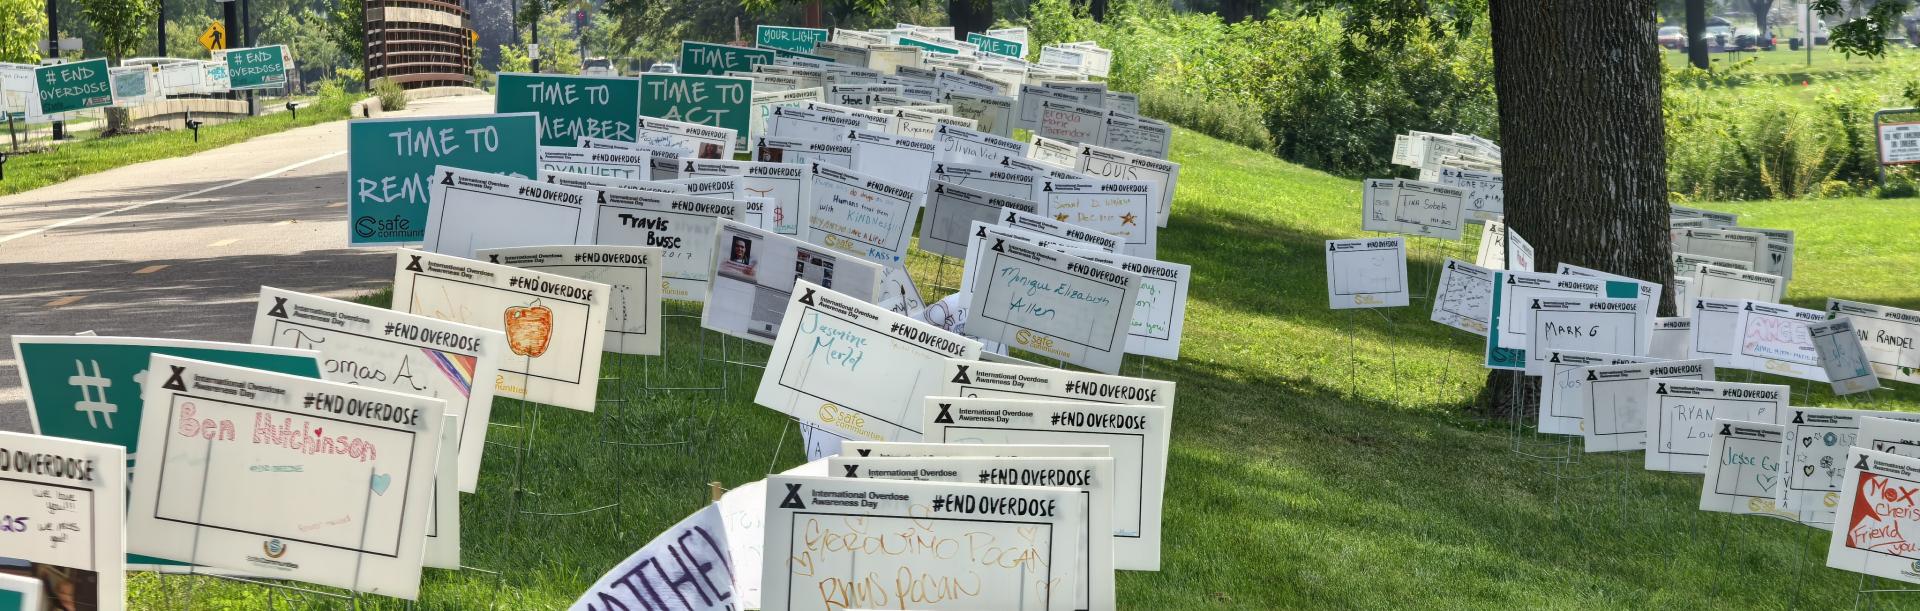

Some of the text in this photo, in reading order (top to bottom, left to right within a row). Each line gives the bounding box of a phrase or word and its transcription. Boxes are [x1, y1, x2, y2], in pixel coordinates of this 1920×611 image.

[764, 30, 821, 43] YOUR LIGHT
[971, 36, 1000, 52] TIME
[1005, 43, 1019, 54] TO
[246, 52, 272, 63] END
[688, 46, 768, 70] TIME TO
[61, 66, 95, 82] END
[229, 64, 282, 77] OVERDOSE
[40, 81, 109, 100] OVERDOSE
[527, 81, 610, 106] TIME TO
[648, 78, 744, 104] TIME TO
[661, 105, 730, 127] ACT
[388, 125, 499, 157] TIME TO
[592, 154, 641, 164] #END OVERDOSE
[652, 150, 680, 160] OVERDOSE
[749, 166, 802, 177] #END OVERDOSE
[990, 171, 1034, 183] #END OVERDOSE
[699, 180, 735, 191] OVERDOSE
[866, 180, 914, 200] #END OVERDOSE
[1118, 185, 1148, 193] OVERDOSE
[518, 186, 584, 205] #END OVERDOSE
[672, 200, 735, 216] #END OVERDOSE
[1005, 201, 1034, 213] OVERDOSE
[378, 214, 410, 230] safe
[618, 213, 669, 231] Travis
[647, 231, 682, 249] Busse
[1066, 229, 1116, 248] #END OVERDOSE
[575, 252, 647, 264] #END OVERDOSE
[428, 260, 494, 278] International Overdose
[1067, 262, 1129, 287] #END OVERDOSE
[1122, 262, 1178, 279] #END OVERDOSE
[509, 276, 594, 301] #END OVERDOSE
[1001, 267, 1050, 296] Monique
[1054, 283, 1110, 307] Elizabeth
[294, 304, 370, 324] International Overdose
[818, 302, 859, 320] Awareness Day
[819, 296, 879, 321] International Overdose
[1010, 297, 1055, 320] Allen
[1589, 301, 1637, 311] #END OVERDOSE
[293, 310, 345, 327] Awareness Day
[384, 321, 481, 352] #END OVERDOSE
[800, 313, 868, 347] Jasmine
[1545, 321, 1599, 340] MARK G
[1877, 329, 1915, 349] RANDEL
[890, 321, 966, 358] #END OVERDOSE
[1031, 333, 1054, 347] safe
[807, 337, 864, 373] Merlot
[976, 370, 1049, 384] International Overdose
[1650, 364, 1702, 376] #END OVERDOSE
[194, 373, 286, 396] International Overdose
[194, 381, 256, 400] Awareness Day
[975, 377, 1025, 389] Awareness Day
[1065, 380, 1157, 402] #END OVERDOSE
[68, 359, 118, 429] #
[1722, 390, 1778, 399] #END OVERDOSE
[303, 392, 420, 426] #END OVERDOSE
[959, 408, 1033, 418] International Overdose
[1674, 405, 1715, 421] RYAN
[838, 410, 866, 429] safe
[996, 416, 1009, 424] Day
[1051, 411, 1147, 430] #END OVERDOSE
[178, 401, 377, 463] Ben Hutchinson
[835, 421, 885, 441] communities
[1722, 446, 1755, 466] Jesse
[14, 450, 95, 482] OVERDOSE
[868, 469, 958, 477] International Overdose
[979, 469, 1091, 486] #END OVERDOSE
[811, 498, 878, 509] Awareness Day
[812, 489, 910, 501] International Overdose
[932, 495, 1055, 517] #END OVERDOSE
